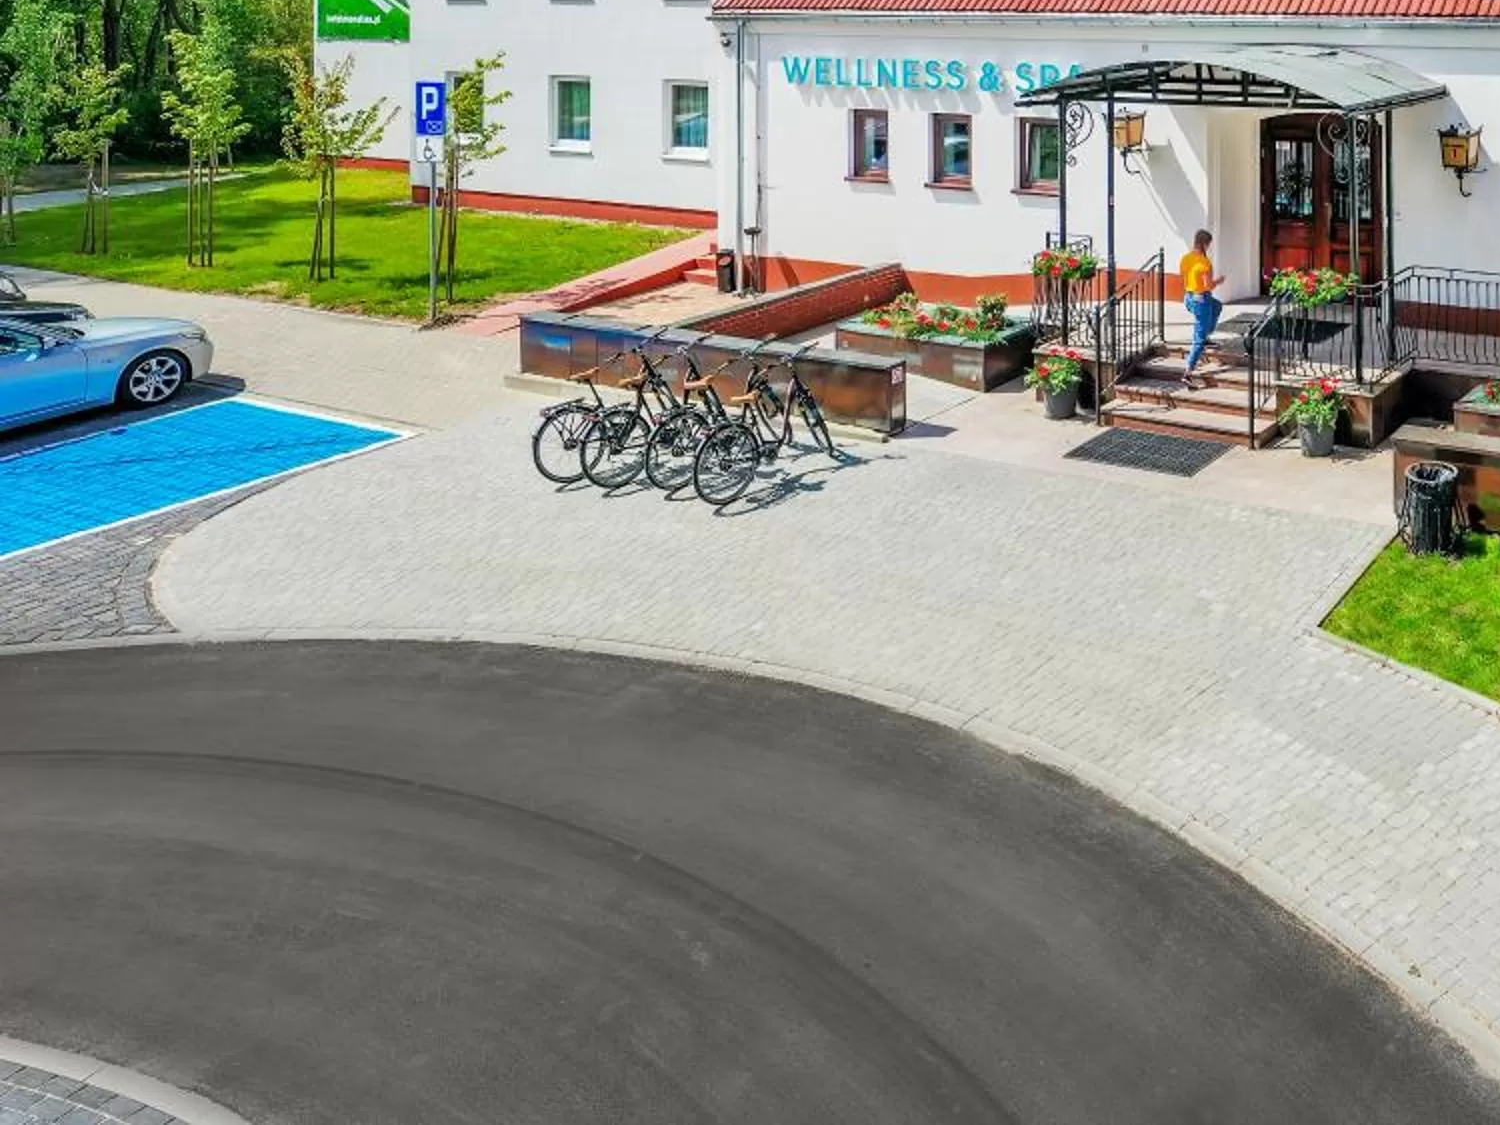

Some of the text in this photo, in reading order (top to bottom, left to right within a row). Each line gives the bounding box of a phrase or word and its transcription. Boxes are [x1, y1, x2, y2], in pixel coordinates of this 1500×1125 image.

[782, 56, 966, 91] WELLNESS
[978, 61, 1001, 92] &
[421, 86, 439, 120] P
